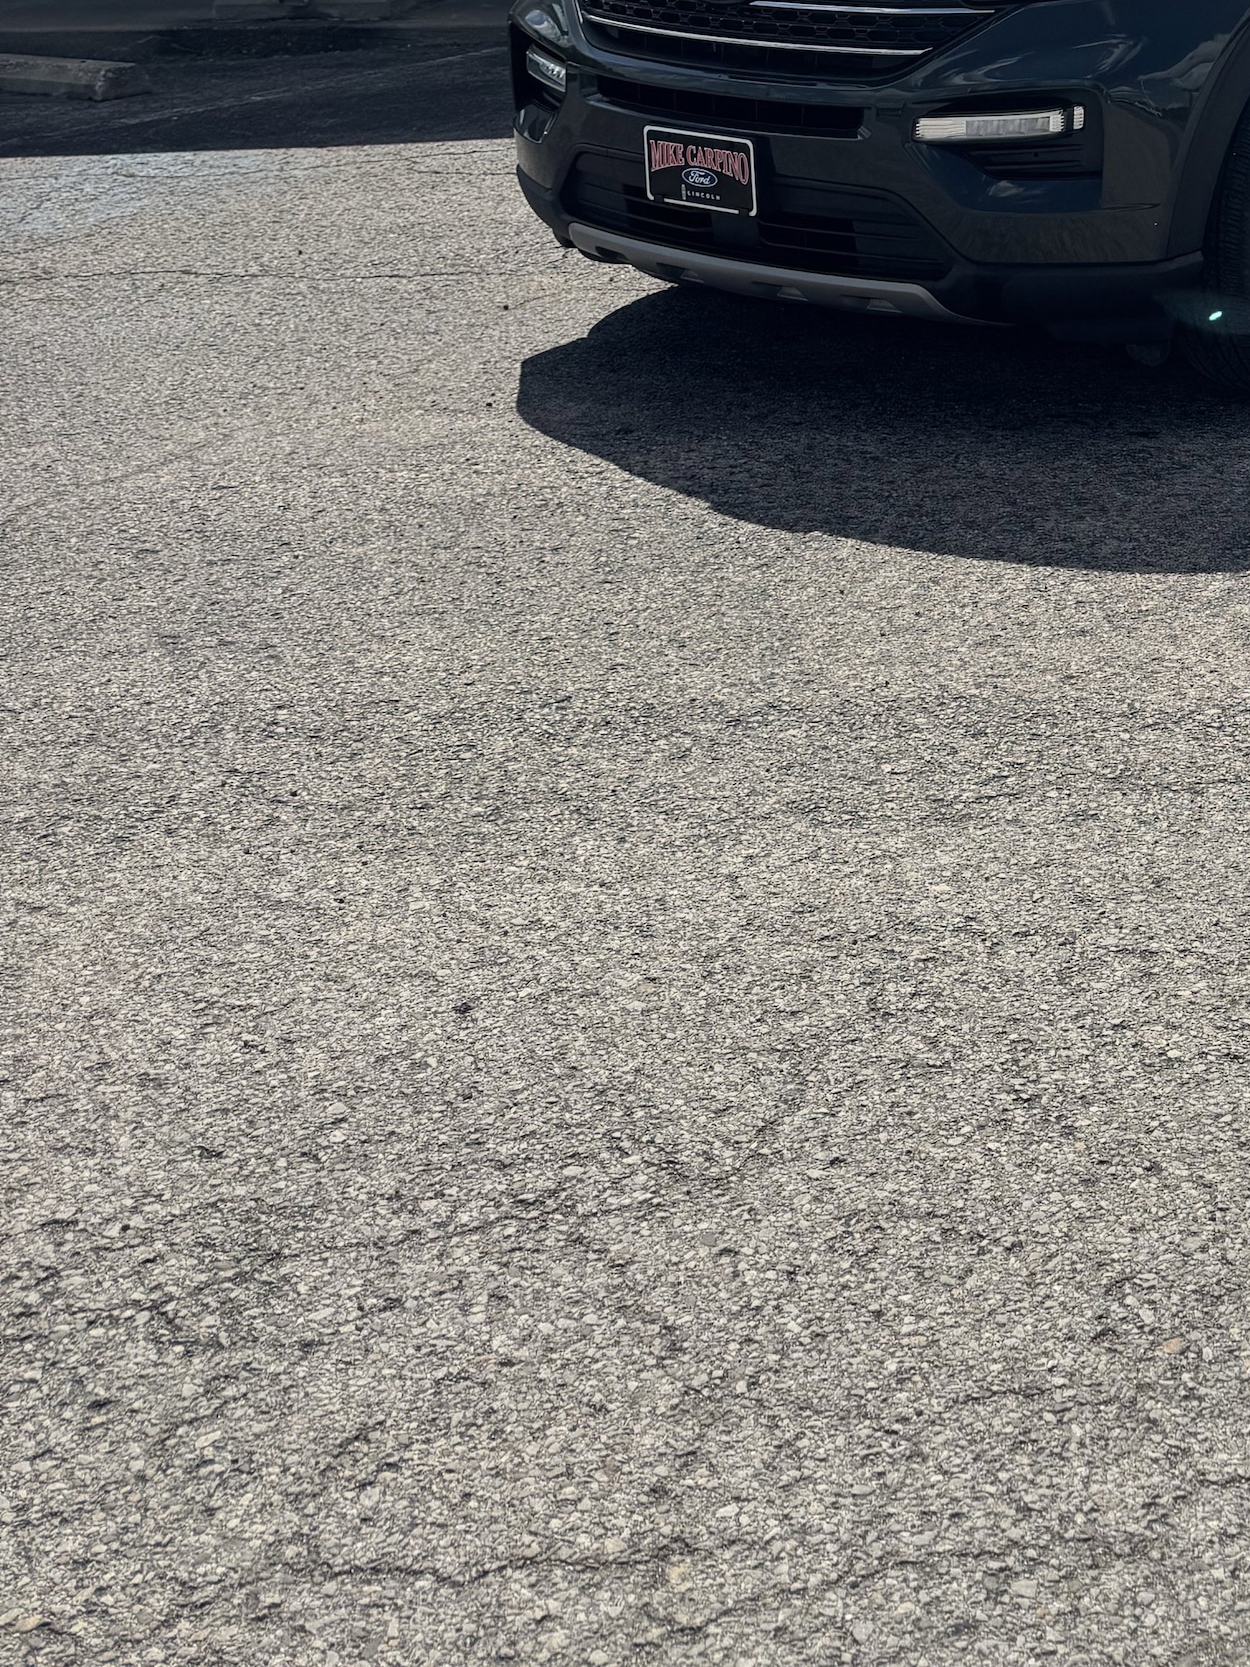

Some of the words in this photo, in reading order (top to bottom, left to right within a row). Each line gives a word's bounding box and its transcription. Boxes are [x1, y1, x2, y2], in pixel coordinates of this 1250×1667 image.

[650, 140, 685, 172] MIKE
[686, 145, 749, 185] CARPINO
[688, 170, 711, 185] Ford
[687, 190, 721, 201] LINCOLN
